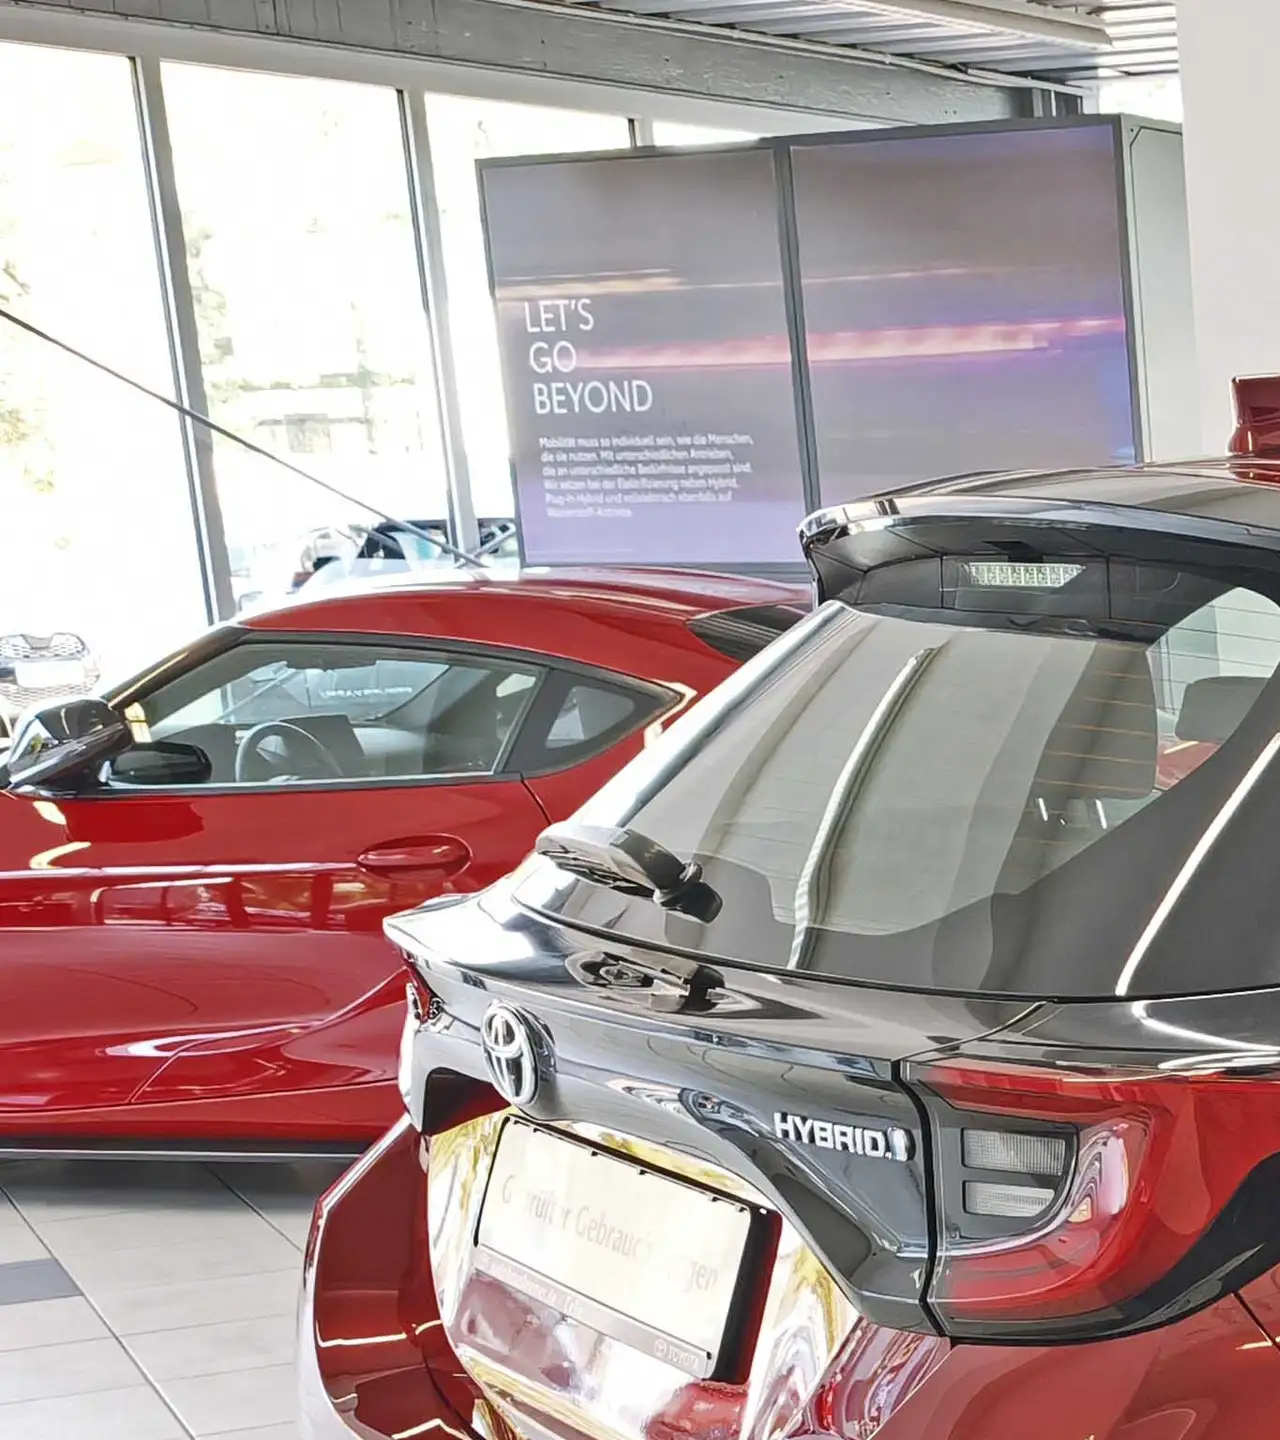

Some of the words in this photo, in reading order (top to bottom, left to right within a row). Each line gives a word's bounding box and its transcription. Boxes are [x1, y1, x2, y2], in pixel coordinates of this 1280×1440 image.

[524, 298, 594, 332] LET'S
[529, 340, 577, 373] GO
[533, 379, 653, 414] BEYOND
[773, 1111, 886, 1158] HYBRID
